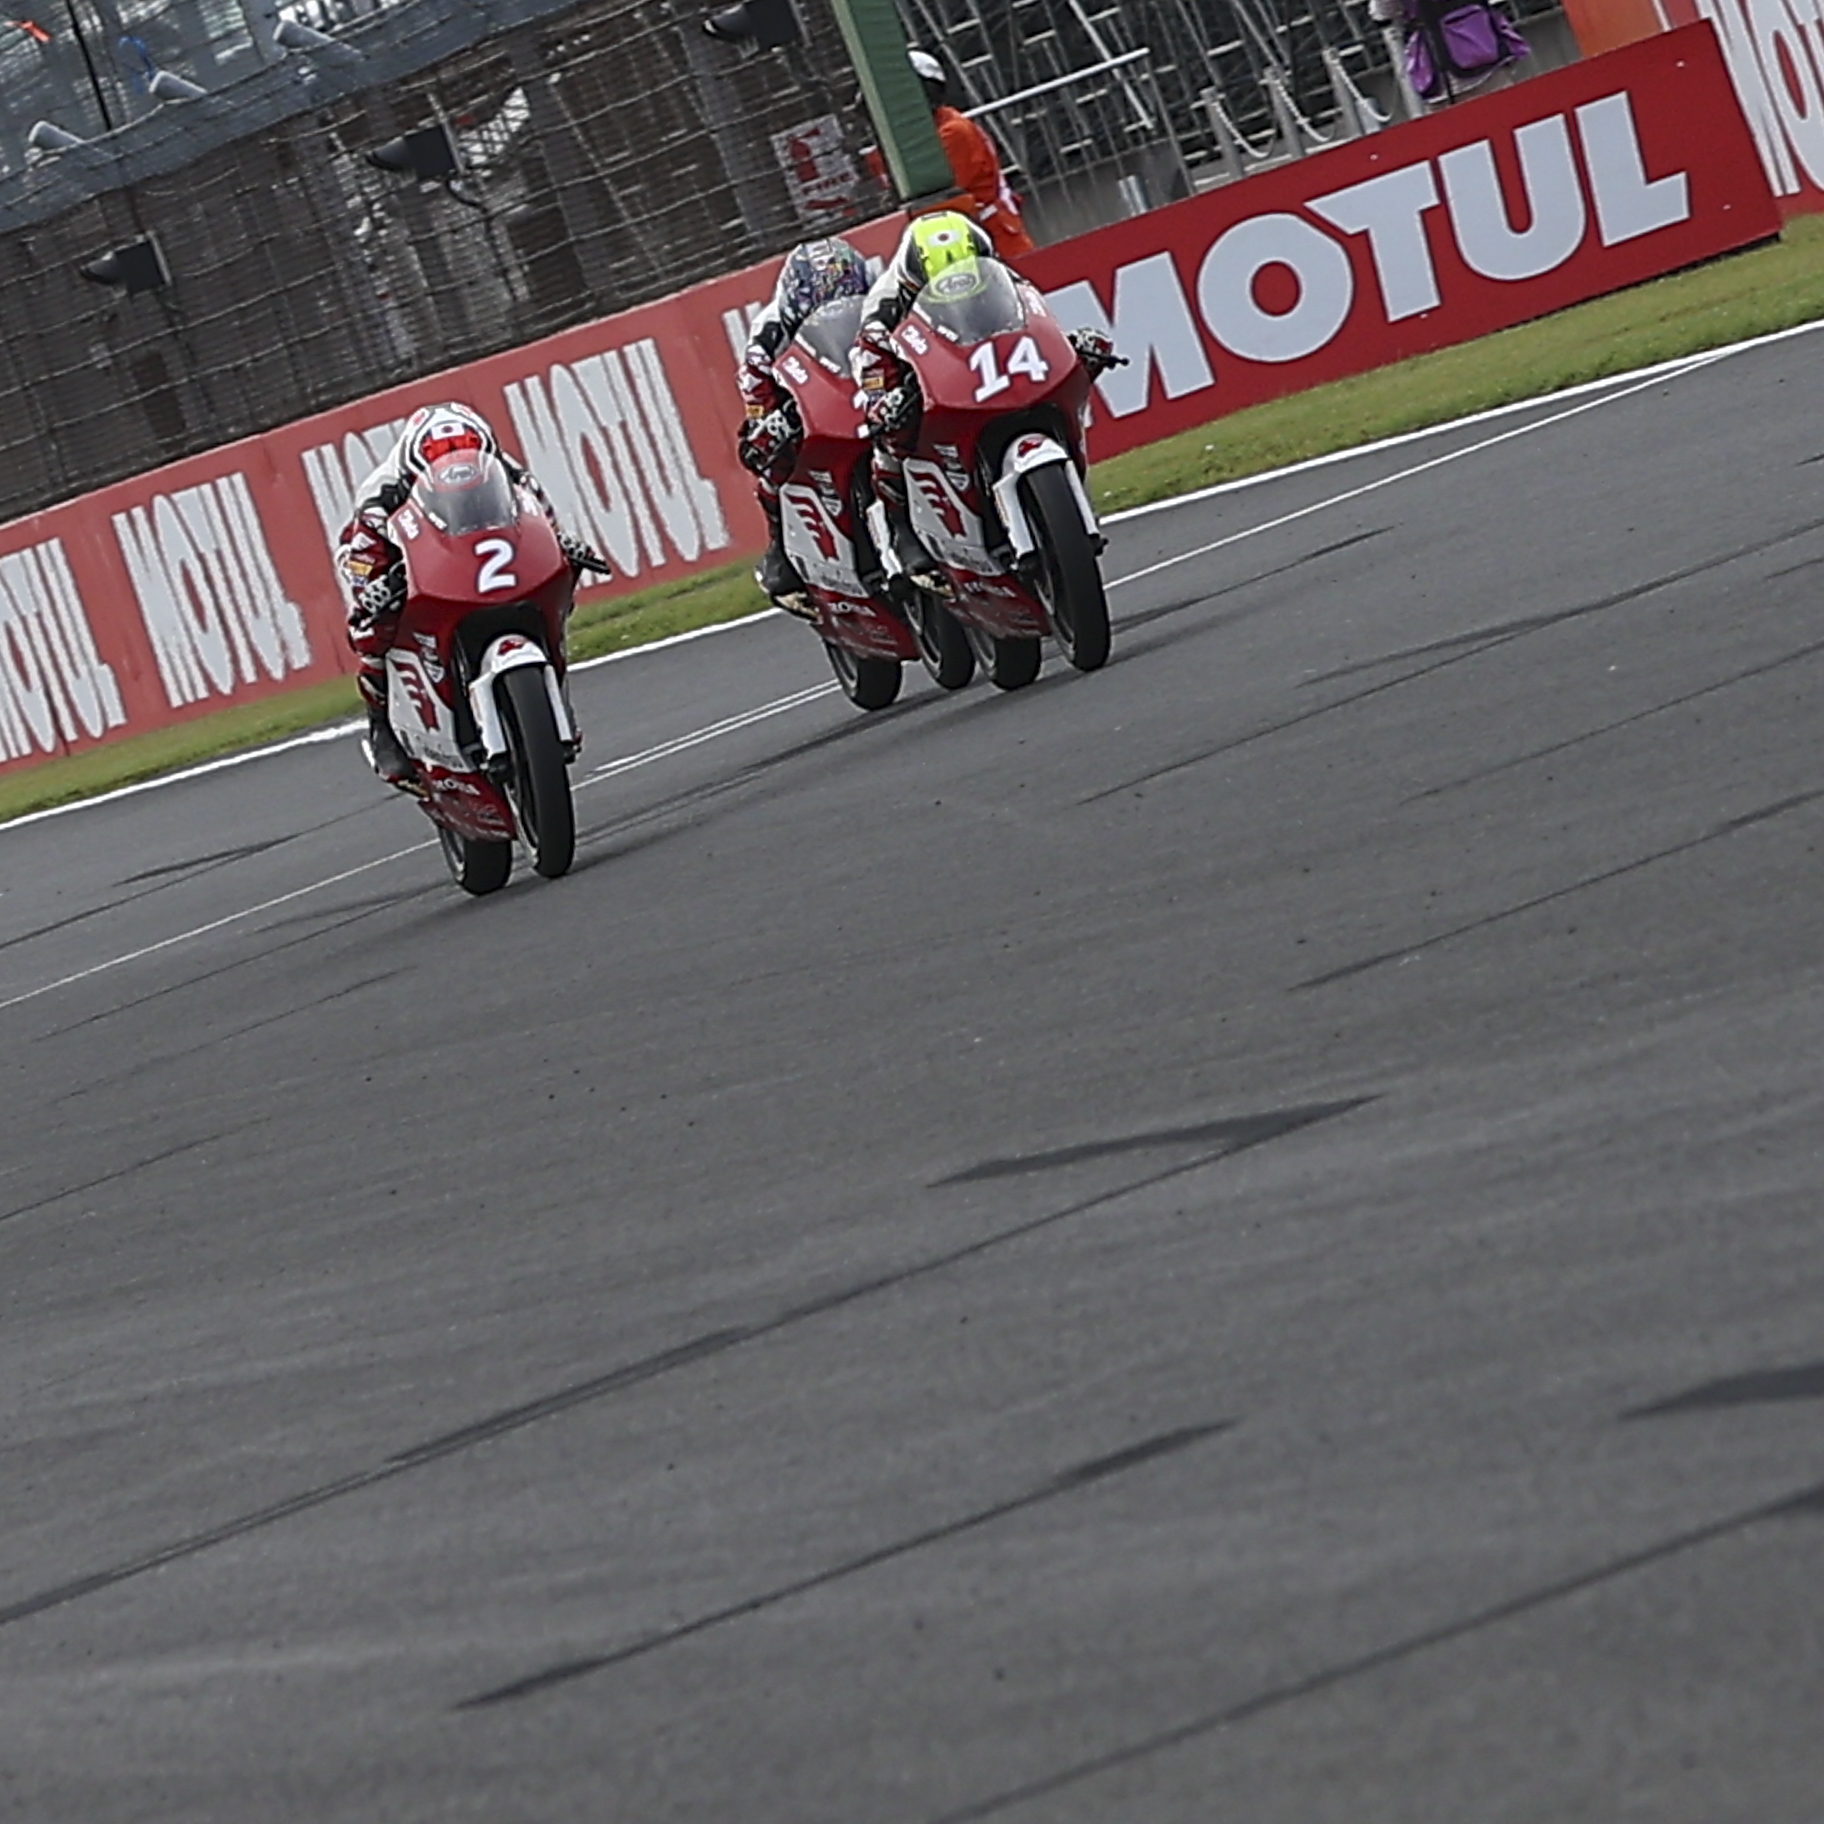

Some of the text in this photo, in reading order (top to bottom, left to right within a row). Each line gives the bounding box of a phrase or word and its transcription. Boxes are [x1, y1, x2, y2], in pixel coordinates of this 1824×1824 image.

[969, 334, 1050, 403] 14
[1038, 90, 1690, 420] MOTUL
[475, 538, 517, 593] 2
[503, 338, 731, 588] MOTUL
[112, 472, 313, 707] MOTUL
